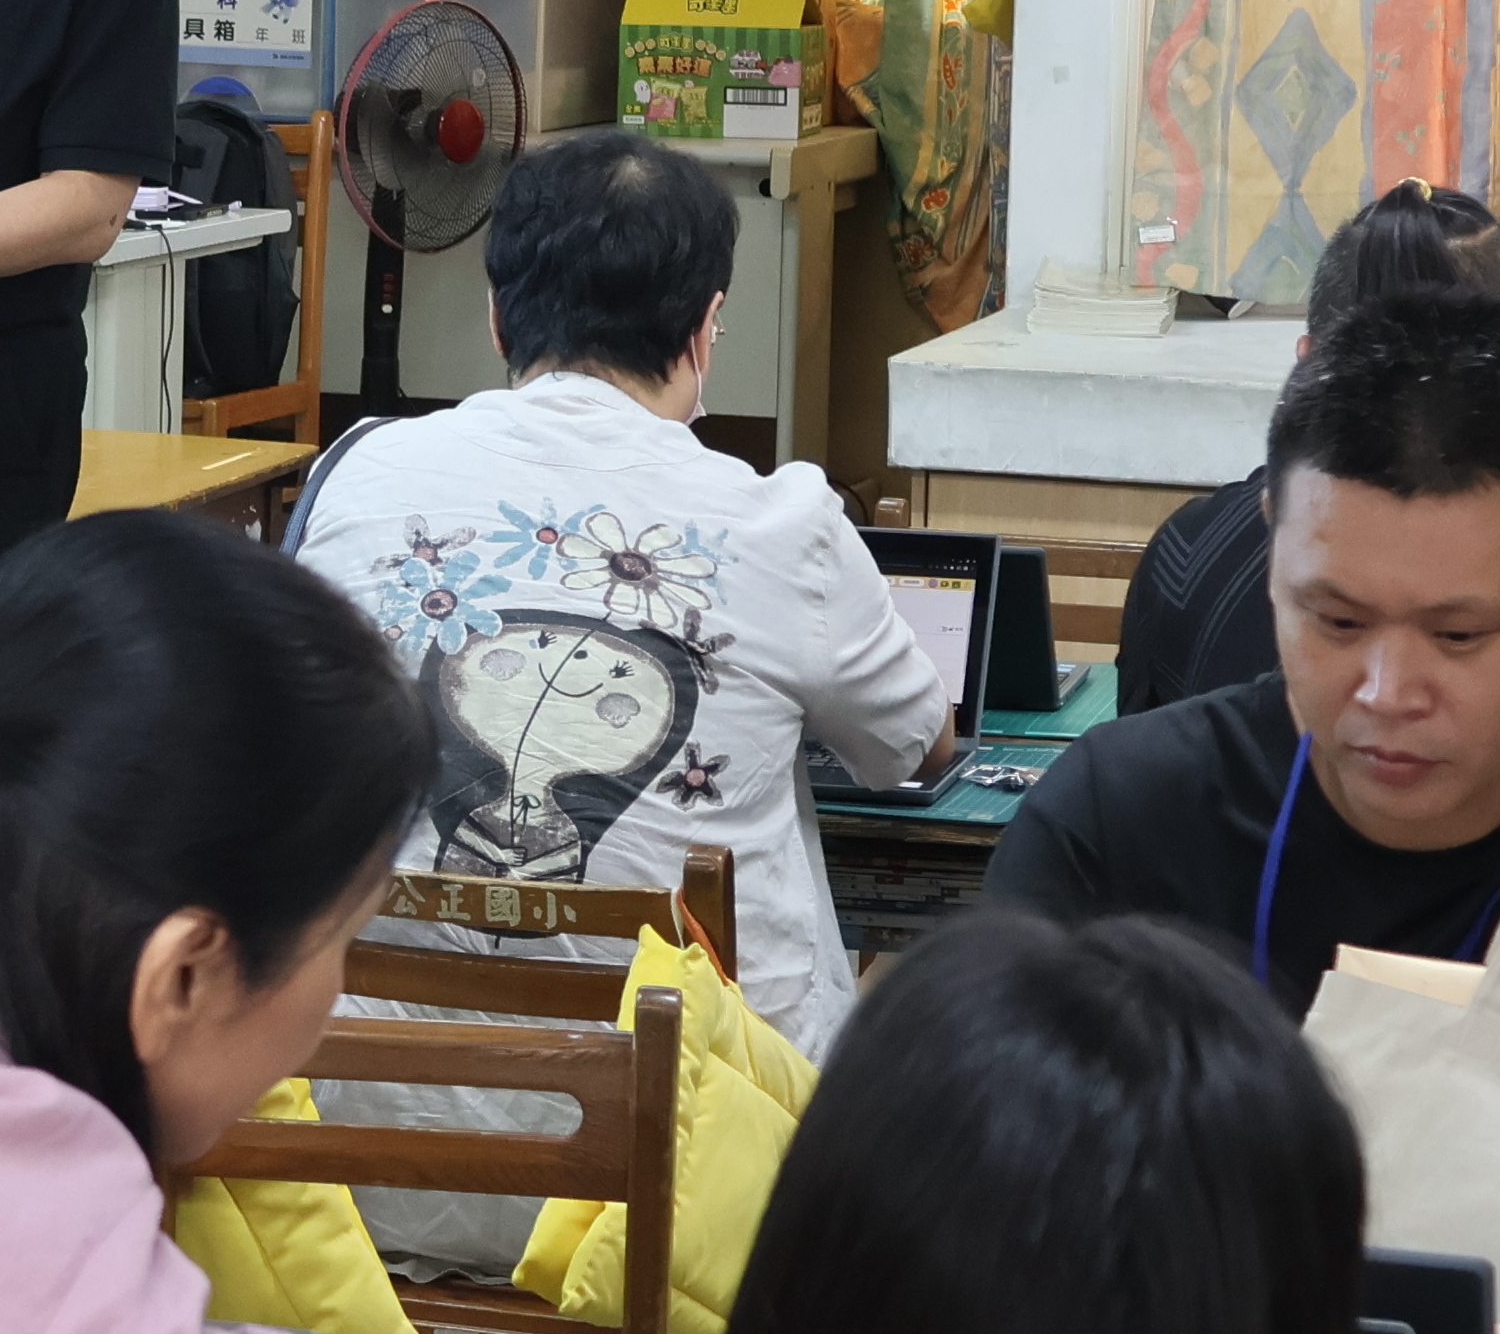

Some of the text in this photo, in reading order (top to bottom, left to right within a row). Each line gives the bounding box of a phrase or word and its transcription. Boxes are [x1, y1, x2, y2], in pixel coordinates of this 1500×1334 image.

[183, 18, 305, 44] 具箱 年 班
[387, 876, 577, 929] 公正國小
